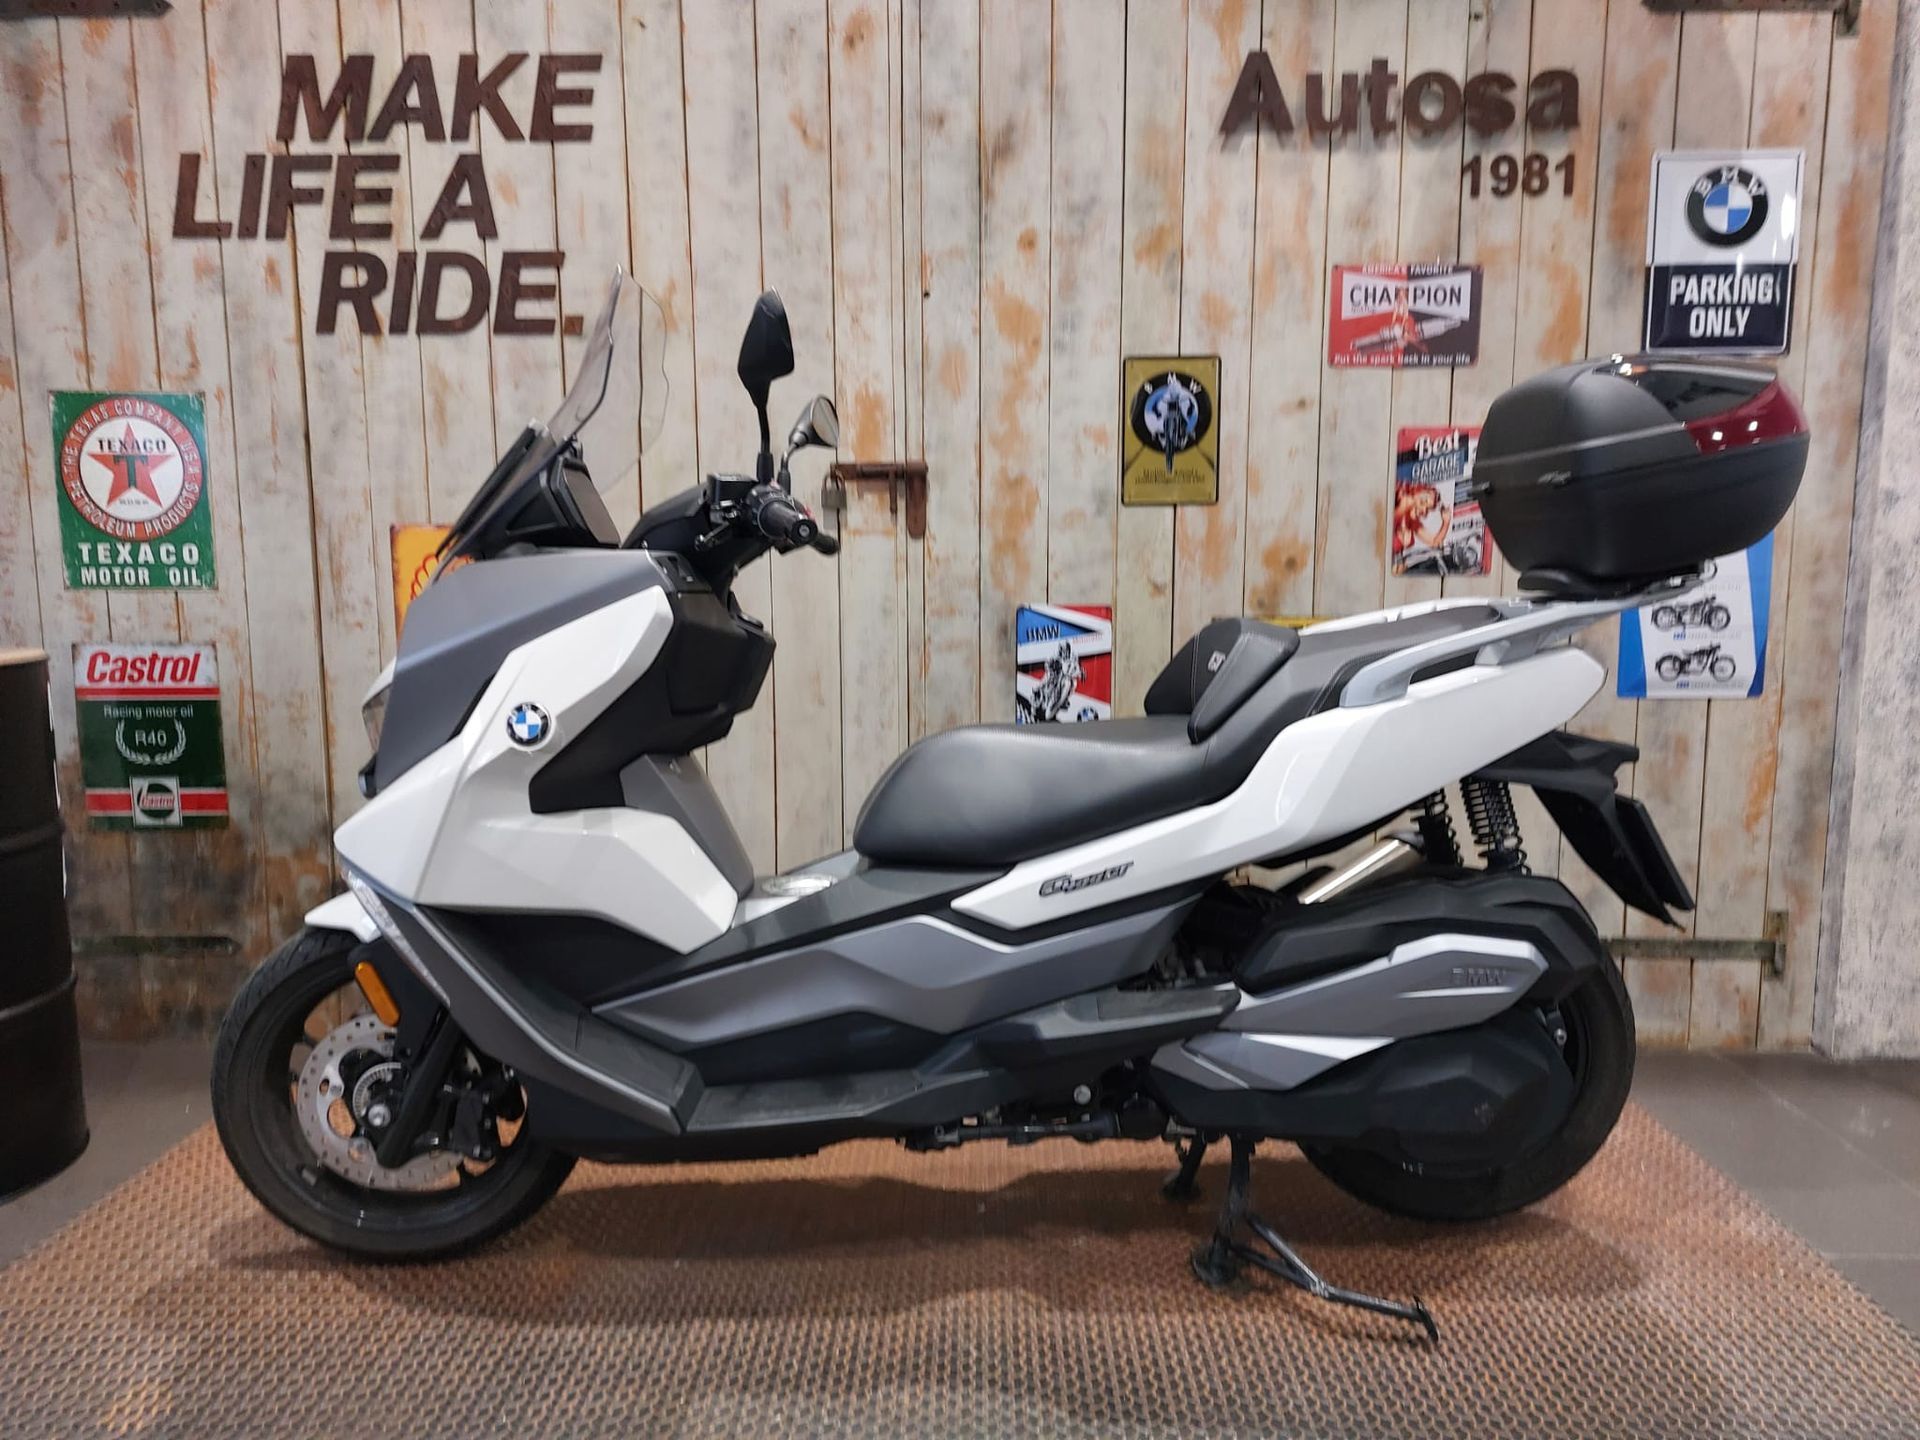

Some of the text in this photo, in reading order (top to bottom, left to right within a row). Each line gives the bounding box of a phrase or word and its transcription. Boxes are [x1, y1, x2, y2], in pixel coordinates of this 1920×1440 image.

[276, 53, 603, 142] MAKE
[1219, 50, 1580, 135] Autosa
[1462, 153, 1575, 198] 1981
[1694, 166, 1768, 198] BMW
[172, 153, 498, 239] LIFE A
[316, 251, 584, 335] RIDE.
[1350, 282, 1462, 307] CHAMPION
[1669, 273, 1775, 306] PARKING
[1689, 306, 1751, 338] ONLY
[70, 402, 109, 442] TEXAS
[114, 399, 182, 436] COMPANY
[98, 438, 167, 453] TEXACO
[1415, 427, 1459, 460] Best
[144, 481, 200, 537] PRODUCTS
[78, 542, 199, 565] TEXACO
[81, 567, 201, 586] MOTOR OIL
[86, 652, 201, 684] Castrol
[104, 704, 194, 720] Racing motor oil
[135, 729, 167, 747] R40
